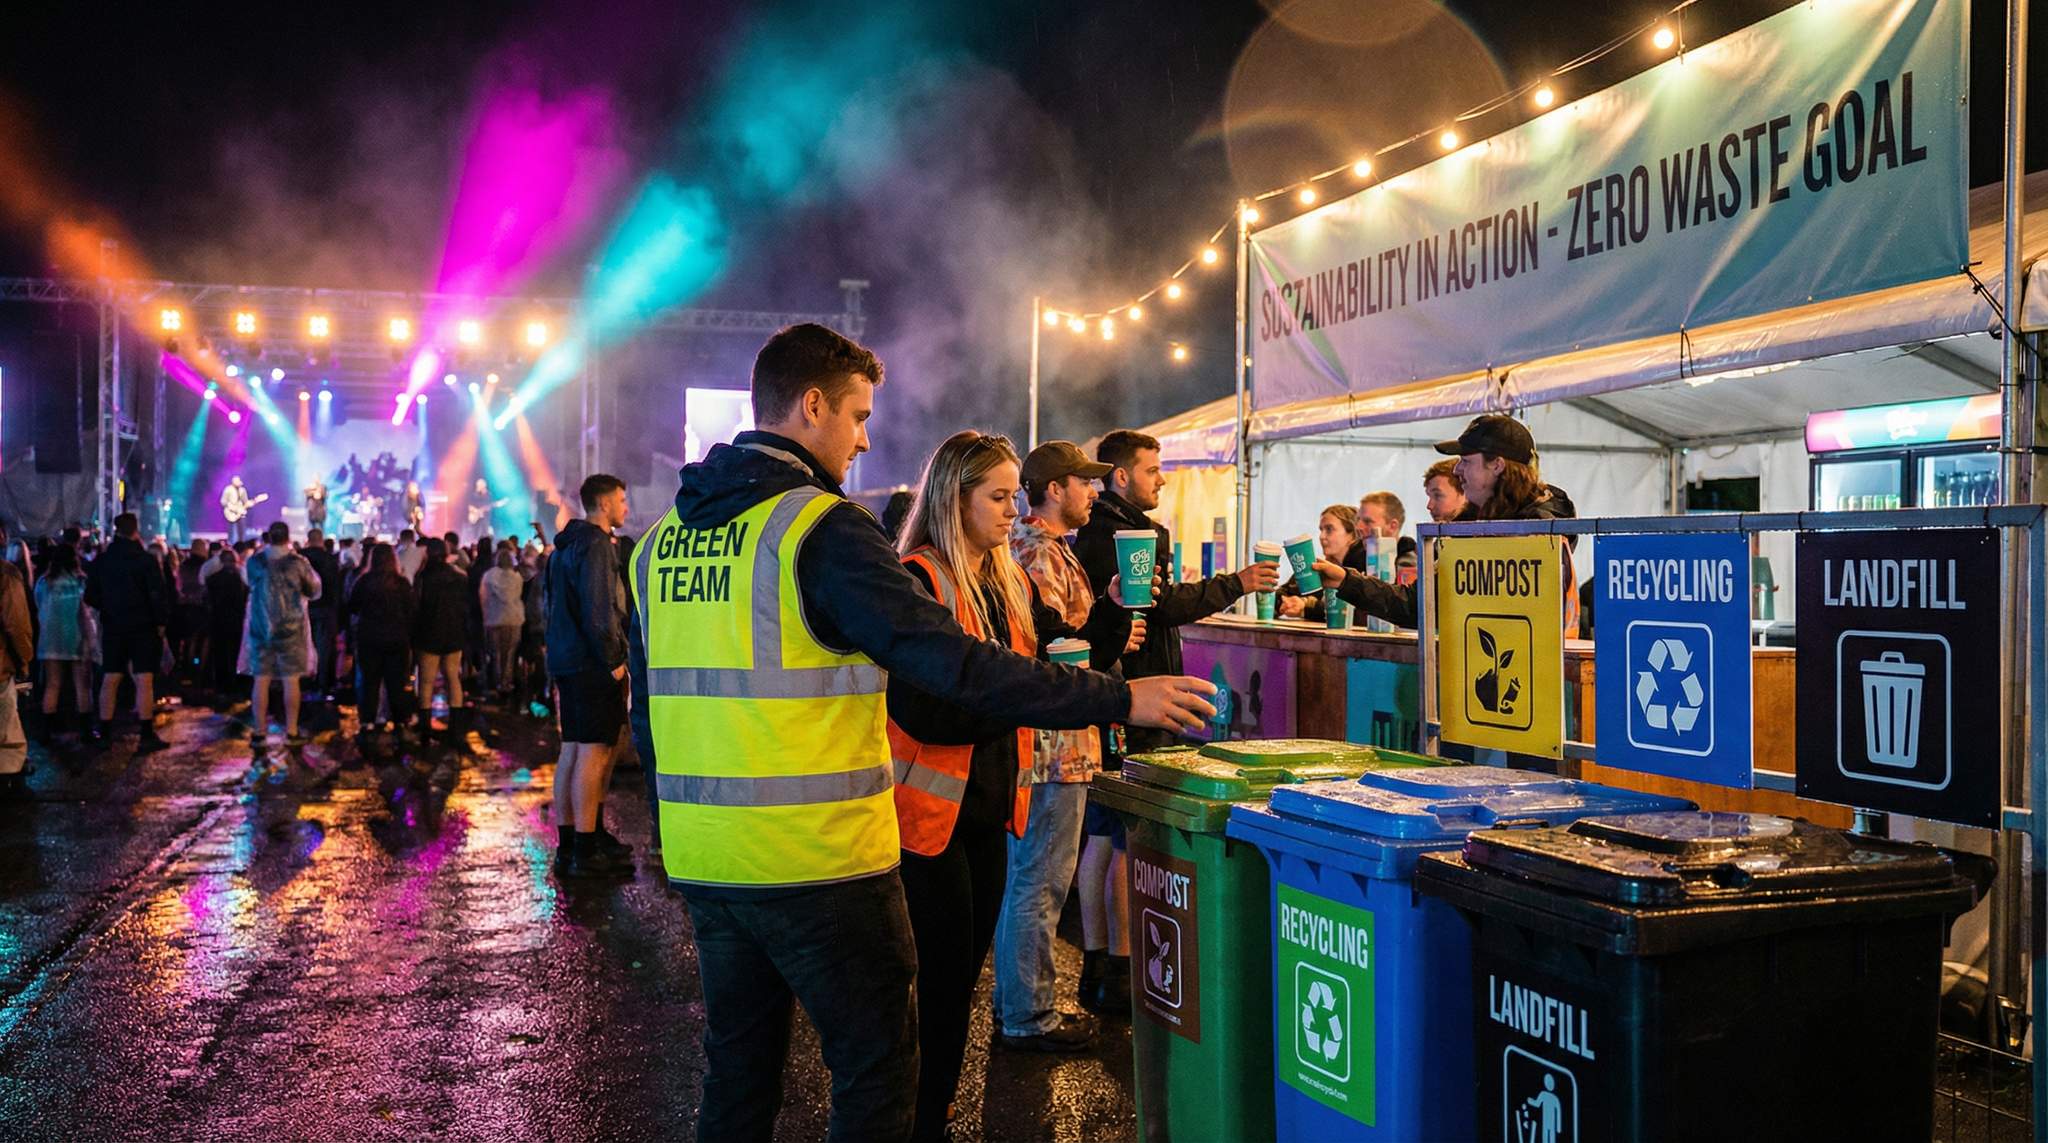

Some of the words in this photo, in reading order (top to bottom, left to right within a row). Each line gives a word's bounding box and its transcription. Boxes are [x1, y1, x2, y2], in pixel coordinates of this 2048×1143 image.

[1261, 243, 1411, 343] SUSTAINABILITY
[1416, 235, 1440, 300] IN
[1445, 200, 1540, 295] ACTION
[1547, 226, 1559, 239] -
[1566, 165, 1650, 260] ZERO
[1659, 114, 1792, 234] WASTE
[1803, 71, 1927, 192] GOAL
[657, 522, 748, 560] GREEN
[658, 565, 732, 602] TEAM
[1454, 558, 1543, 597] COMPOST
[1608, 558, 1734, 604] RECYCLING
[1823, 558, 1966, 610] LANDFILL
[1133, 857, 1190, 911] COMPOST
[1280, 901, 1368, 970] RECYCLING
[1489, 974, 1595, 1060] LANDFILL
